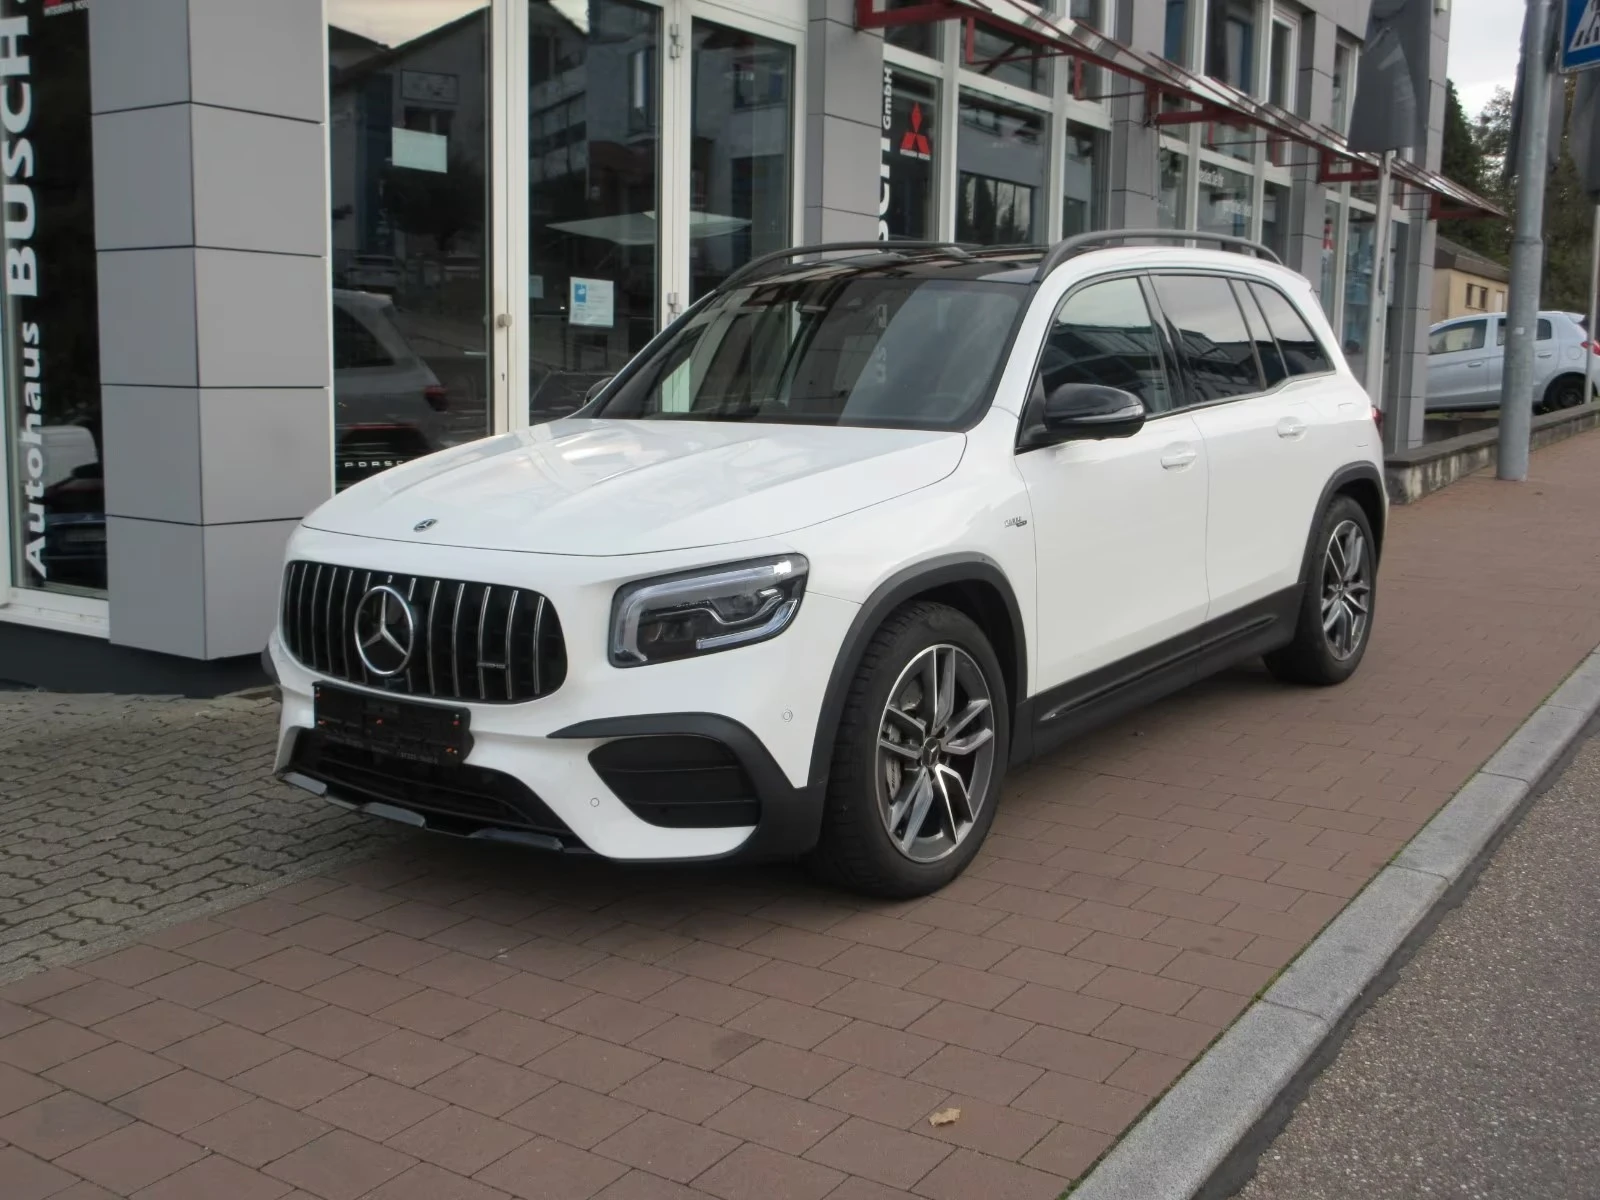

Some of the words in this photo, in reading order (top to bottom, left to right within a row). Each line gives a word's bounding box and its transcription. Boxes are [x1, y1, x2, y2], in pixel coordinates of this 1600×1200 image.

[0, 15, 38, 297] BUSCH
[882, 67, 893, 131] GmbH
[22, 321, 47, 579] Autohaus
